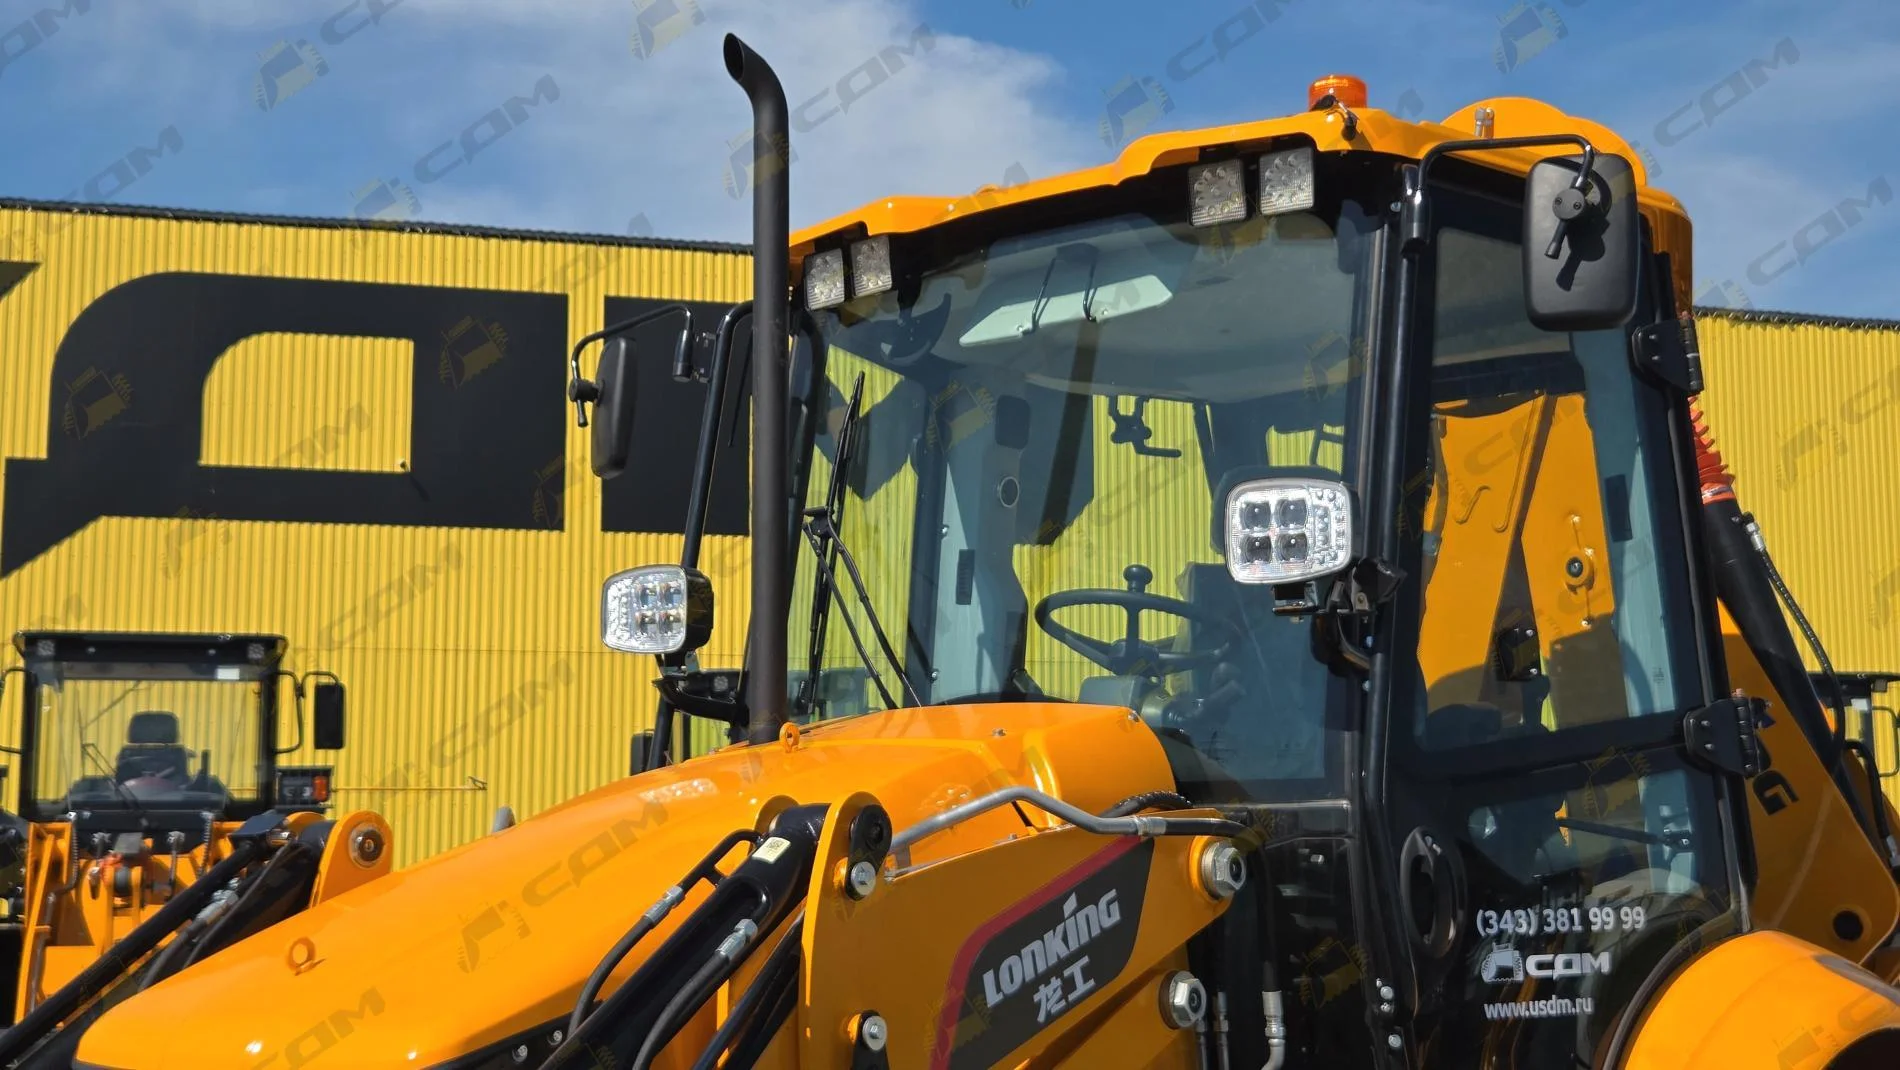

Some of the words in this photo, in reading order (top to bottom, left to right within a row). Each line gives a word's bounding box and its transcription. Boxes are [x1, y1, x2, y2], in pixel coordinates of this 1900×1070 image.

[1476, 907, 1537, 937] (343)
[1543, 907, 1583, 932] 381
[1588, 906, 1614, 931] 99
[1620, 905, 1645, 930] 99
[1484, 994, 1595, 1020] www.usdm.ru
